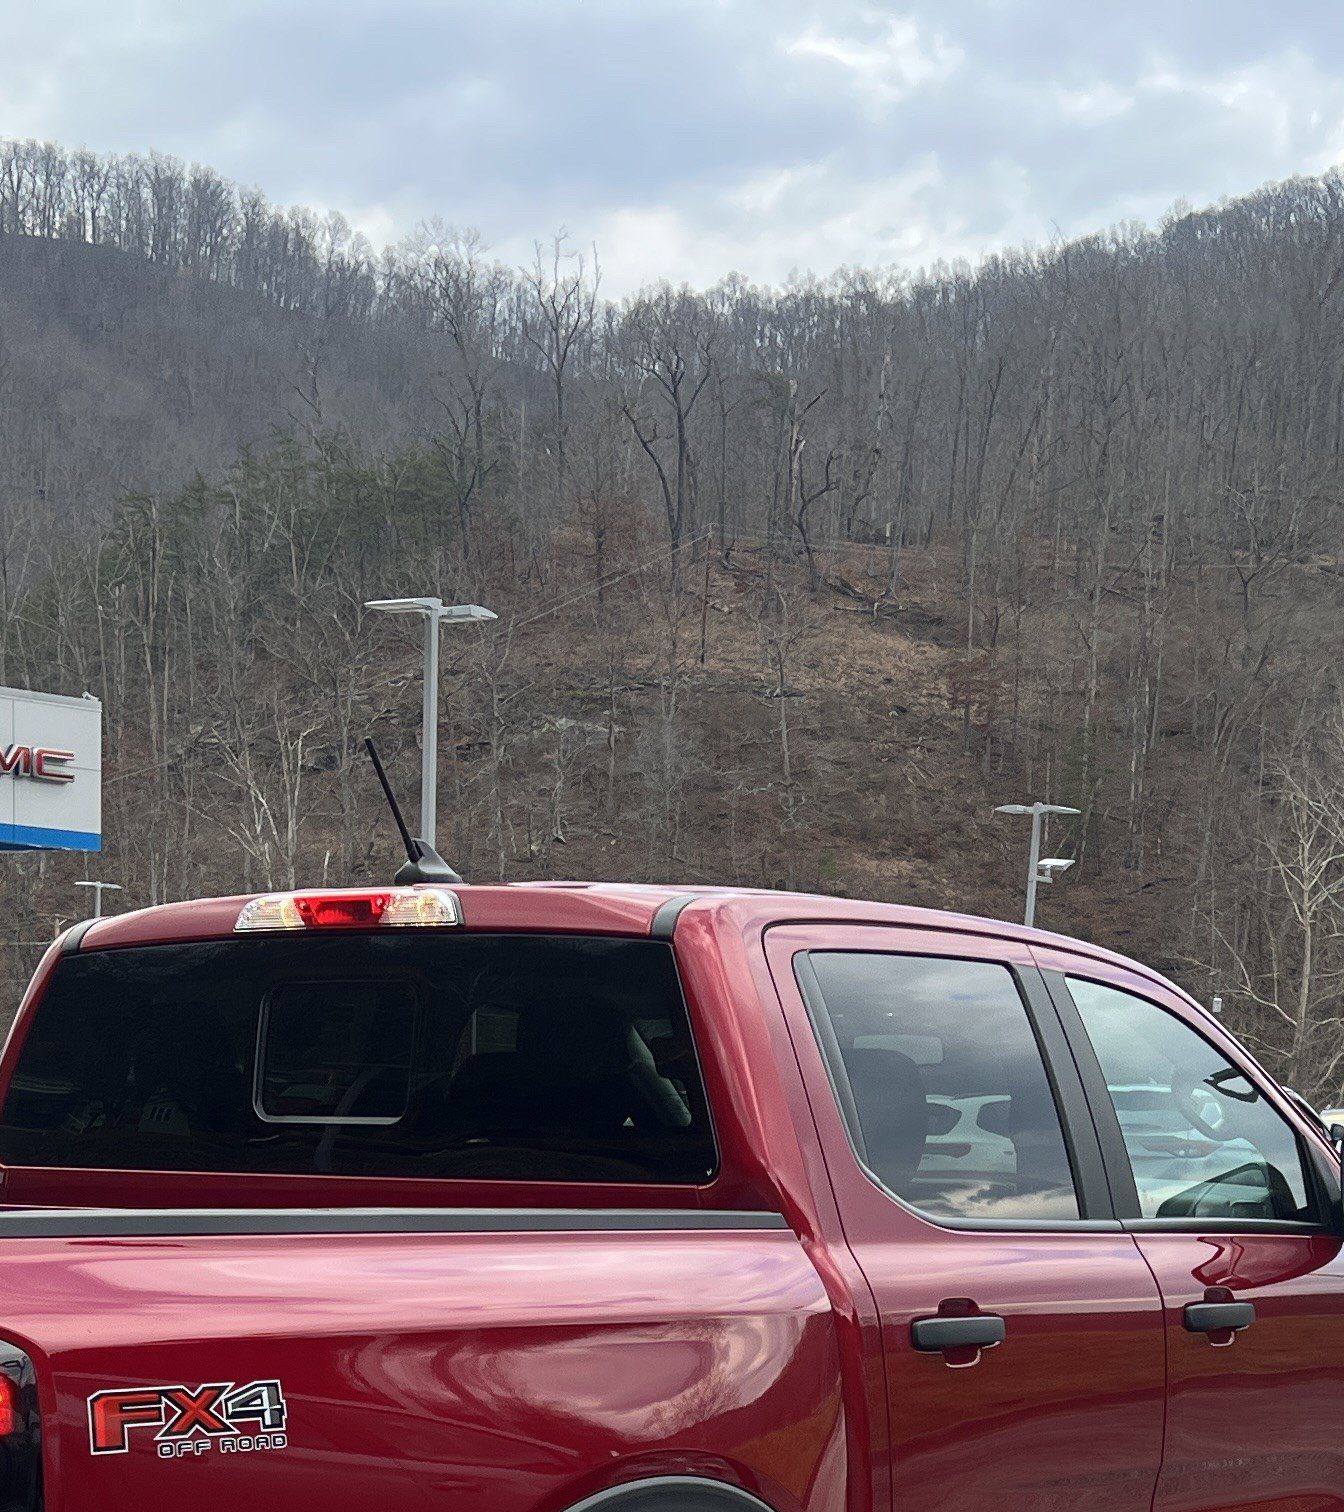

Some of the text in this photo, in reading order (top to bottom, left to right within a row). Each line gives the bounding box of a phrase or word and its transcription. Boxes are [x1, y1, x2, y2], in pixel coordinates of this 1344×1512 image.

[87, 1379, 287, 1455] FX4
[158, 1433, 288, 1459] OFF ROAD
